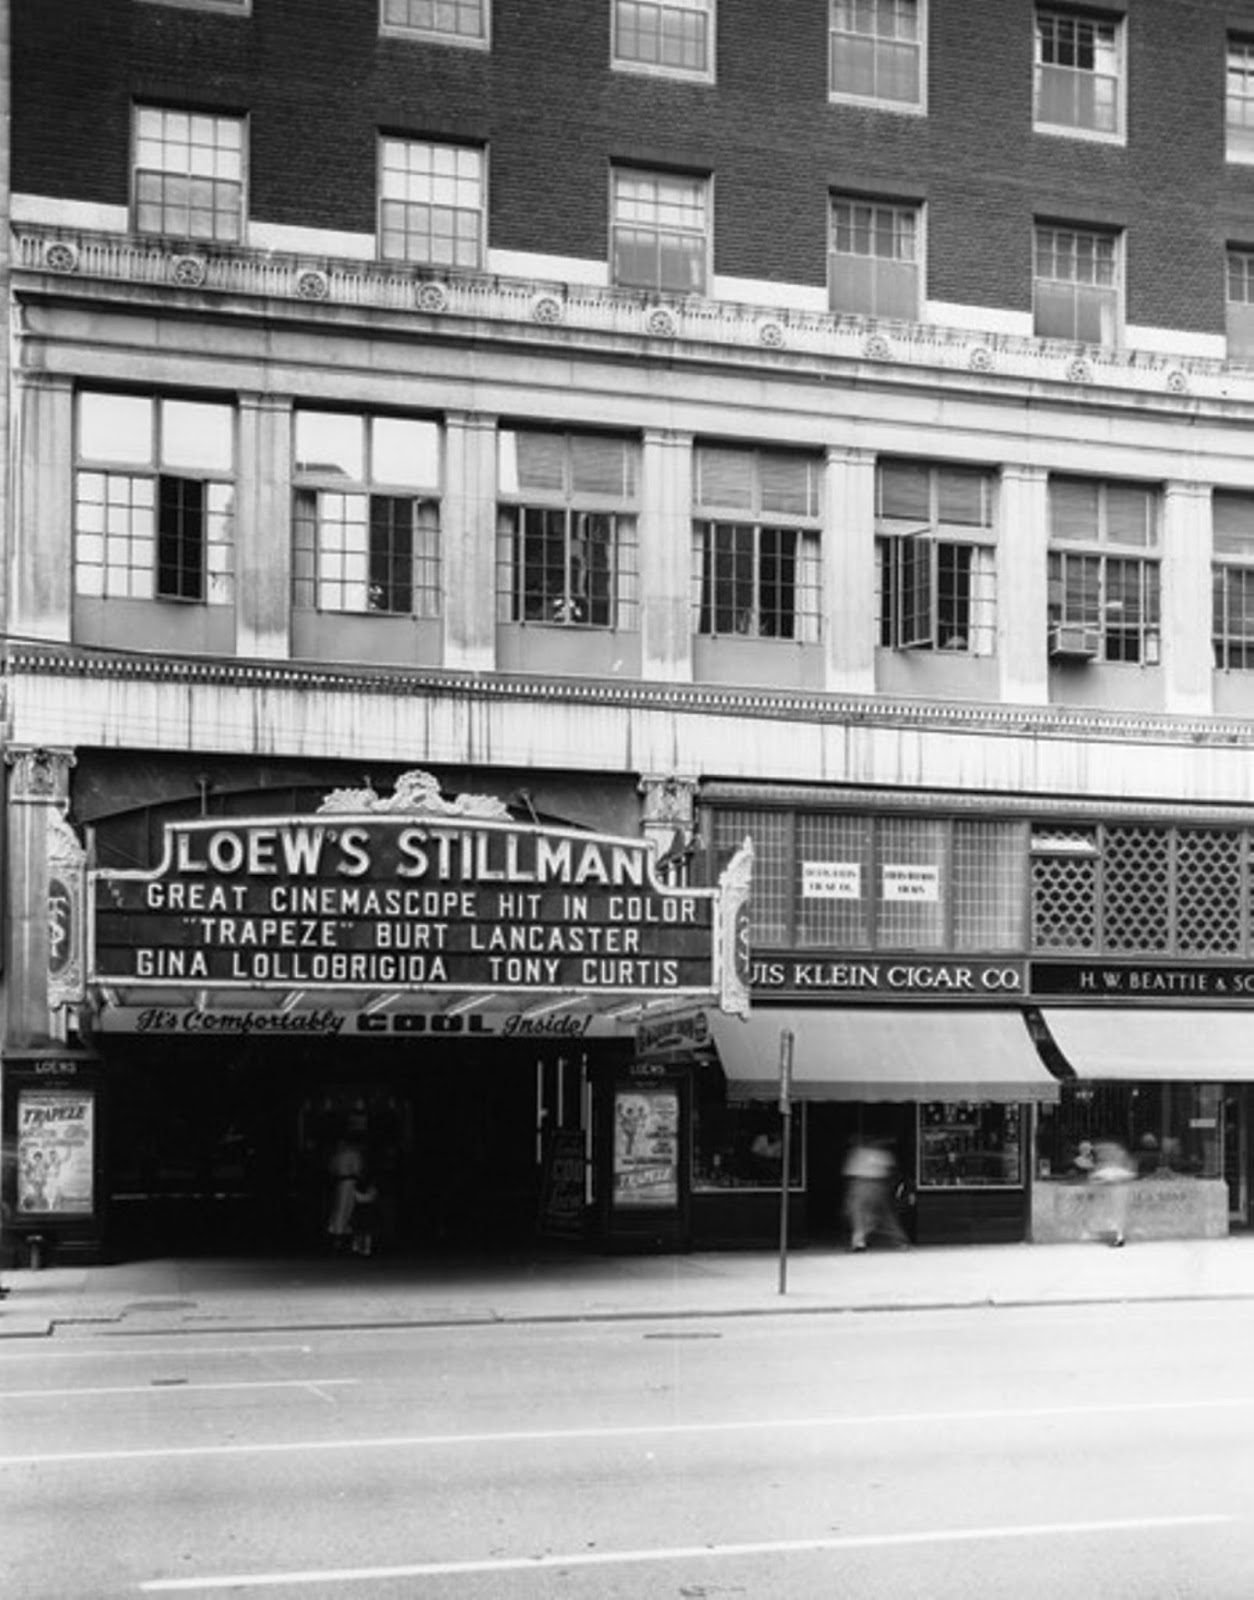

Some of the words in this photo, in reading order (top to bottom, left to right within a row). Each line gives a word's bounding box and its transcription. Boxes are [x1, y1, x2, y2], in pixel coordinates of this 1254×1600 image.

[177, 828, 370, 876] LOEW'S
[396, 828, 643, 886] STILLMAN
[147, 882, 248, 911] GREAT
[271, 887, 476, 917] CINEMASCOPE
[499, 893, 541, 919] HIT
[563, 895, 588, 920] IN
[608, 896, 696, 922] COLOR
[183, 917, 354, 947] "TRAPEZE"
[376, 922, 448, 949] BURT
[471, 925, 639, 953] LANCASTER
[137, 949, 208, 976] GINA
[232, 953, 447, 981] LOLLOBRIGIDA
[489, 957, 560, 983] TONY
[582, 959, 678, 984] CURTIS
[794, 963, 880, 987] KLEIN
[886, 966, 975, 989] CIGAR
[1129, 972, 1206, 991] BEATTIE
[1215, 977, 1227, 991] &
[136, 1009, 178, 1031] It's
[182, 1007, 346, 1036] Comfortably
[356, 1013, 494, 1033] COOL
[502, 1013, 593, 1036] Inside!
